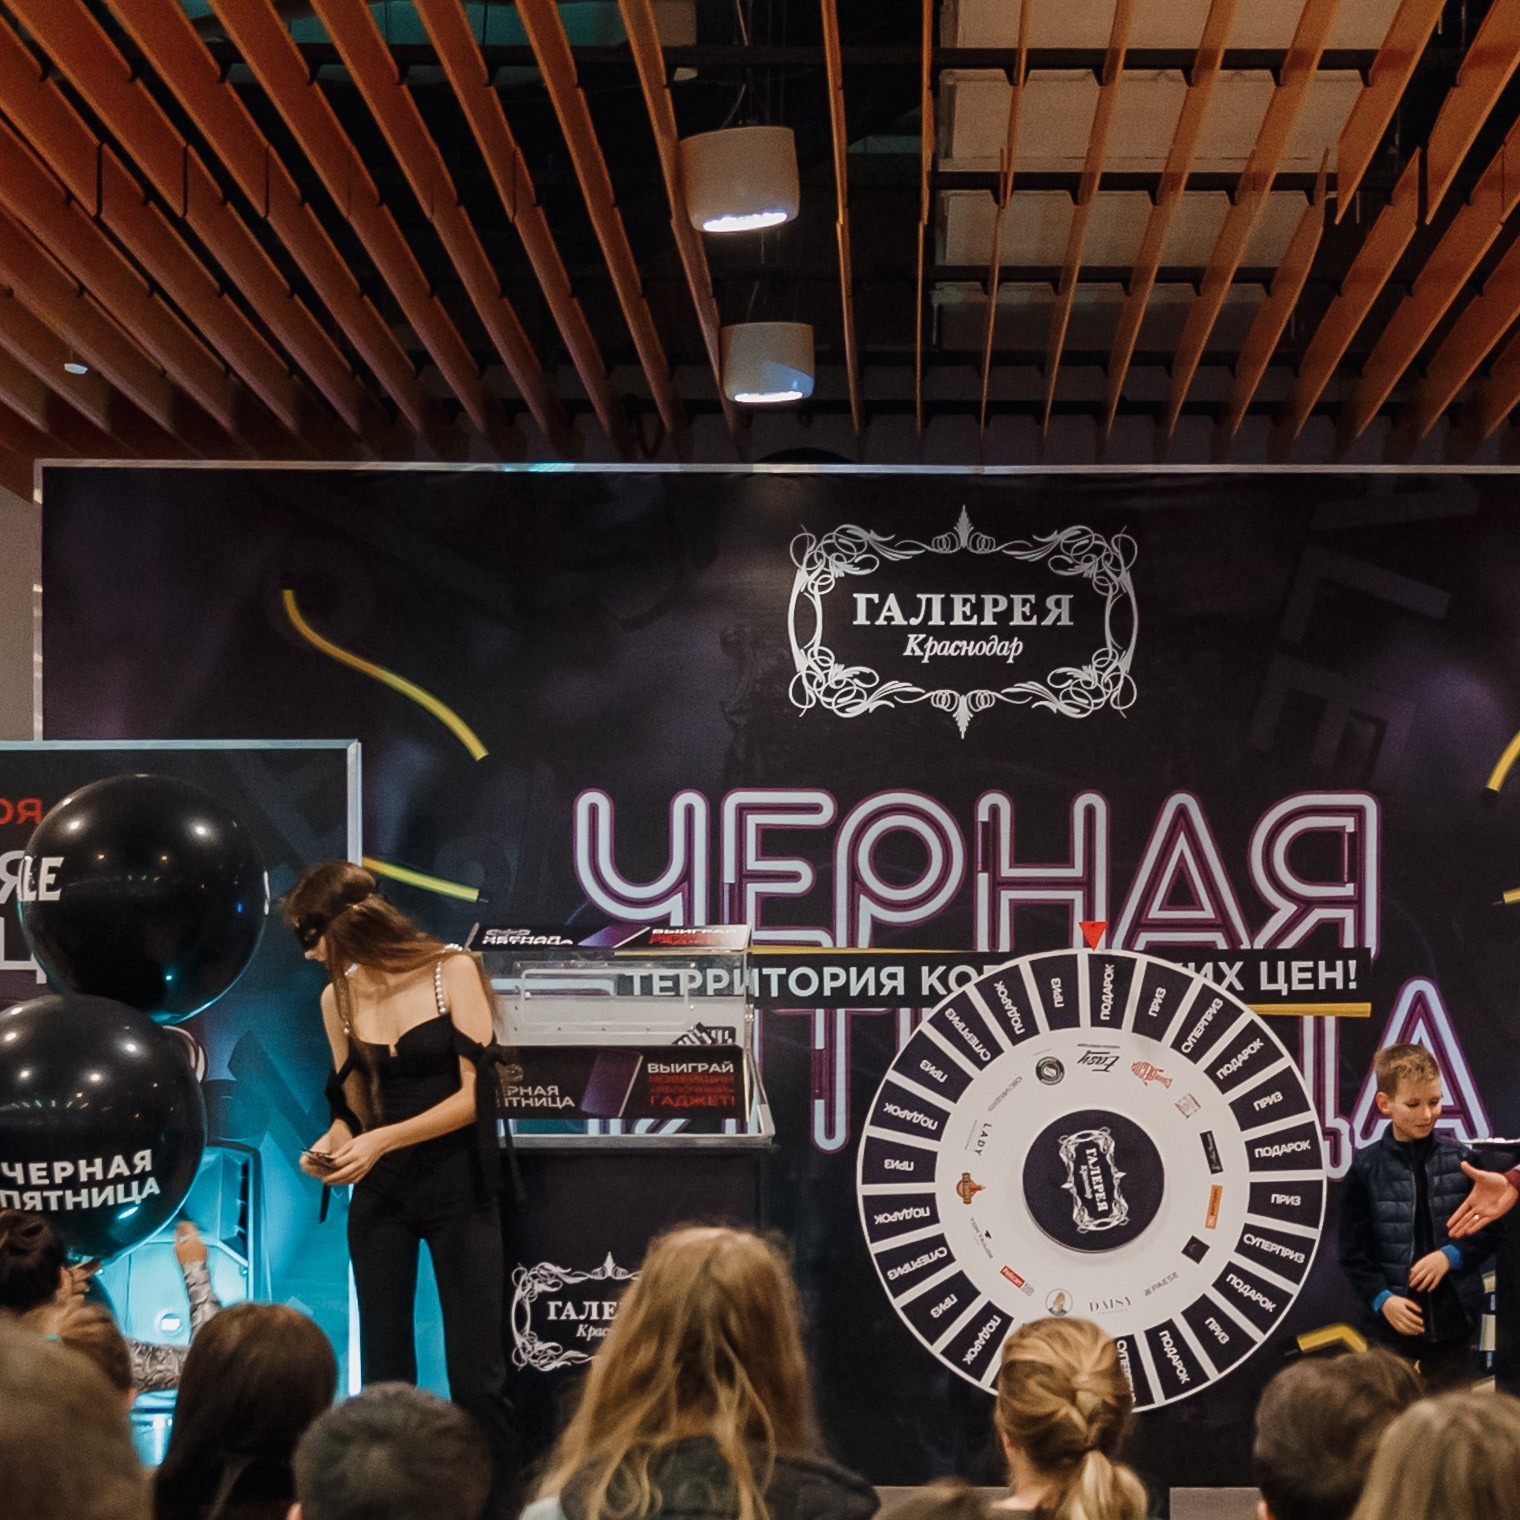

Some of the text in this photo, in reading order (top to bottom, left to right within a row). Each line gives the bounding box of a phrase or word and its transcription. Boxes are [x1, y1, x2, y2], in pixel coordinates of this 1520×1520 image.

[852, 593, 1075, 627] ГАЛЕРЕЯ
[903, 634, 1024, 664] Краснодар
[17, 856, 65, 901] LE
[574, 788, 1379, 958] ЧЕРНАЯ
[625, 966, 905, 998] ТЕРРИТОРИЯ
[1259, 960, 1358, 996] ЦЕН!
[1050, 977, 1065, 1008] ПРИЗ
[1099, 963, 1115, 1021] ПОДАРОК
[993, 980, 1026, 1035] ПОДАРОК
[1147, 986, 1167, 1017] ПРИЗ
[944, 1007, 991, 1062] СУПЕРПРИЗ
[1180, 997, 1224, 1053] СУПЕРПРИЗ
[647, 1061, 735, 1074] ВЫИГРАЙ
[919, 1059, 948, 1083] ПРИЗ
[1215, 1037, 1265, 1080] ПОДАРОК
[503, 1096, 576, 1109] ТНИЦА
[505, 1085, 560, 1097] РНАЯ
[1252, 1091, 1284, 1112] ПРИЗ
[883, 1102, 939, 1131] ПОДАРОК
[974, 1122, 993, 1157] LADY
[1254, 1139, 1312, 1159] ПОДАРОК
[0, 1149, 153, 1186] ЧЕРНАЯ
[883, 1158, 915, 1172] ПРИЗ
[1085, 1147, 1109, 1212] ГАЛЕРЕЯ
[873, 1206, 931, 1225] ПОДАРОК
[1270, 1193, 1302, 1207] ПРИЗ
[886, 1246, 948, 1281] СУПЕРПРИЗ
[1243, 1233, 1306, 1264] СУПЕРПРИЗ
[929, 1293, 958, 1318] ПРИЗ
[1089, 1296, 1132, 1313] DAISY
[1225, 1273, 1277, 1313] ПОДАРОК
[547, 1301, 618, 1321] ГАЛЕ
[962, 1314, 1002, 1365] ПОДАРОК
[1204, 1317, 1230, 1345] ПРИЗ
[1158, 1329, 1191, 1385] ПОДАРОК
